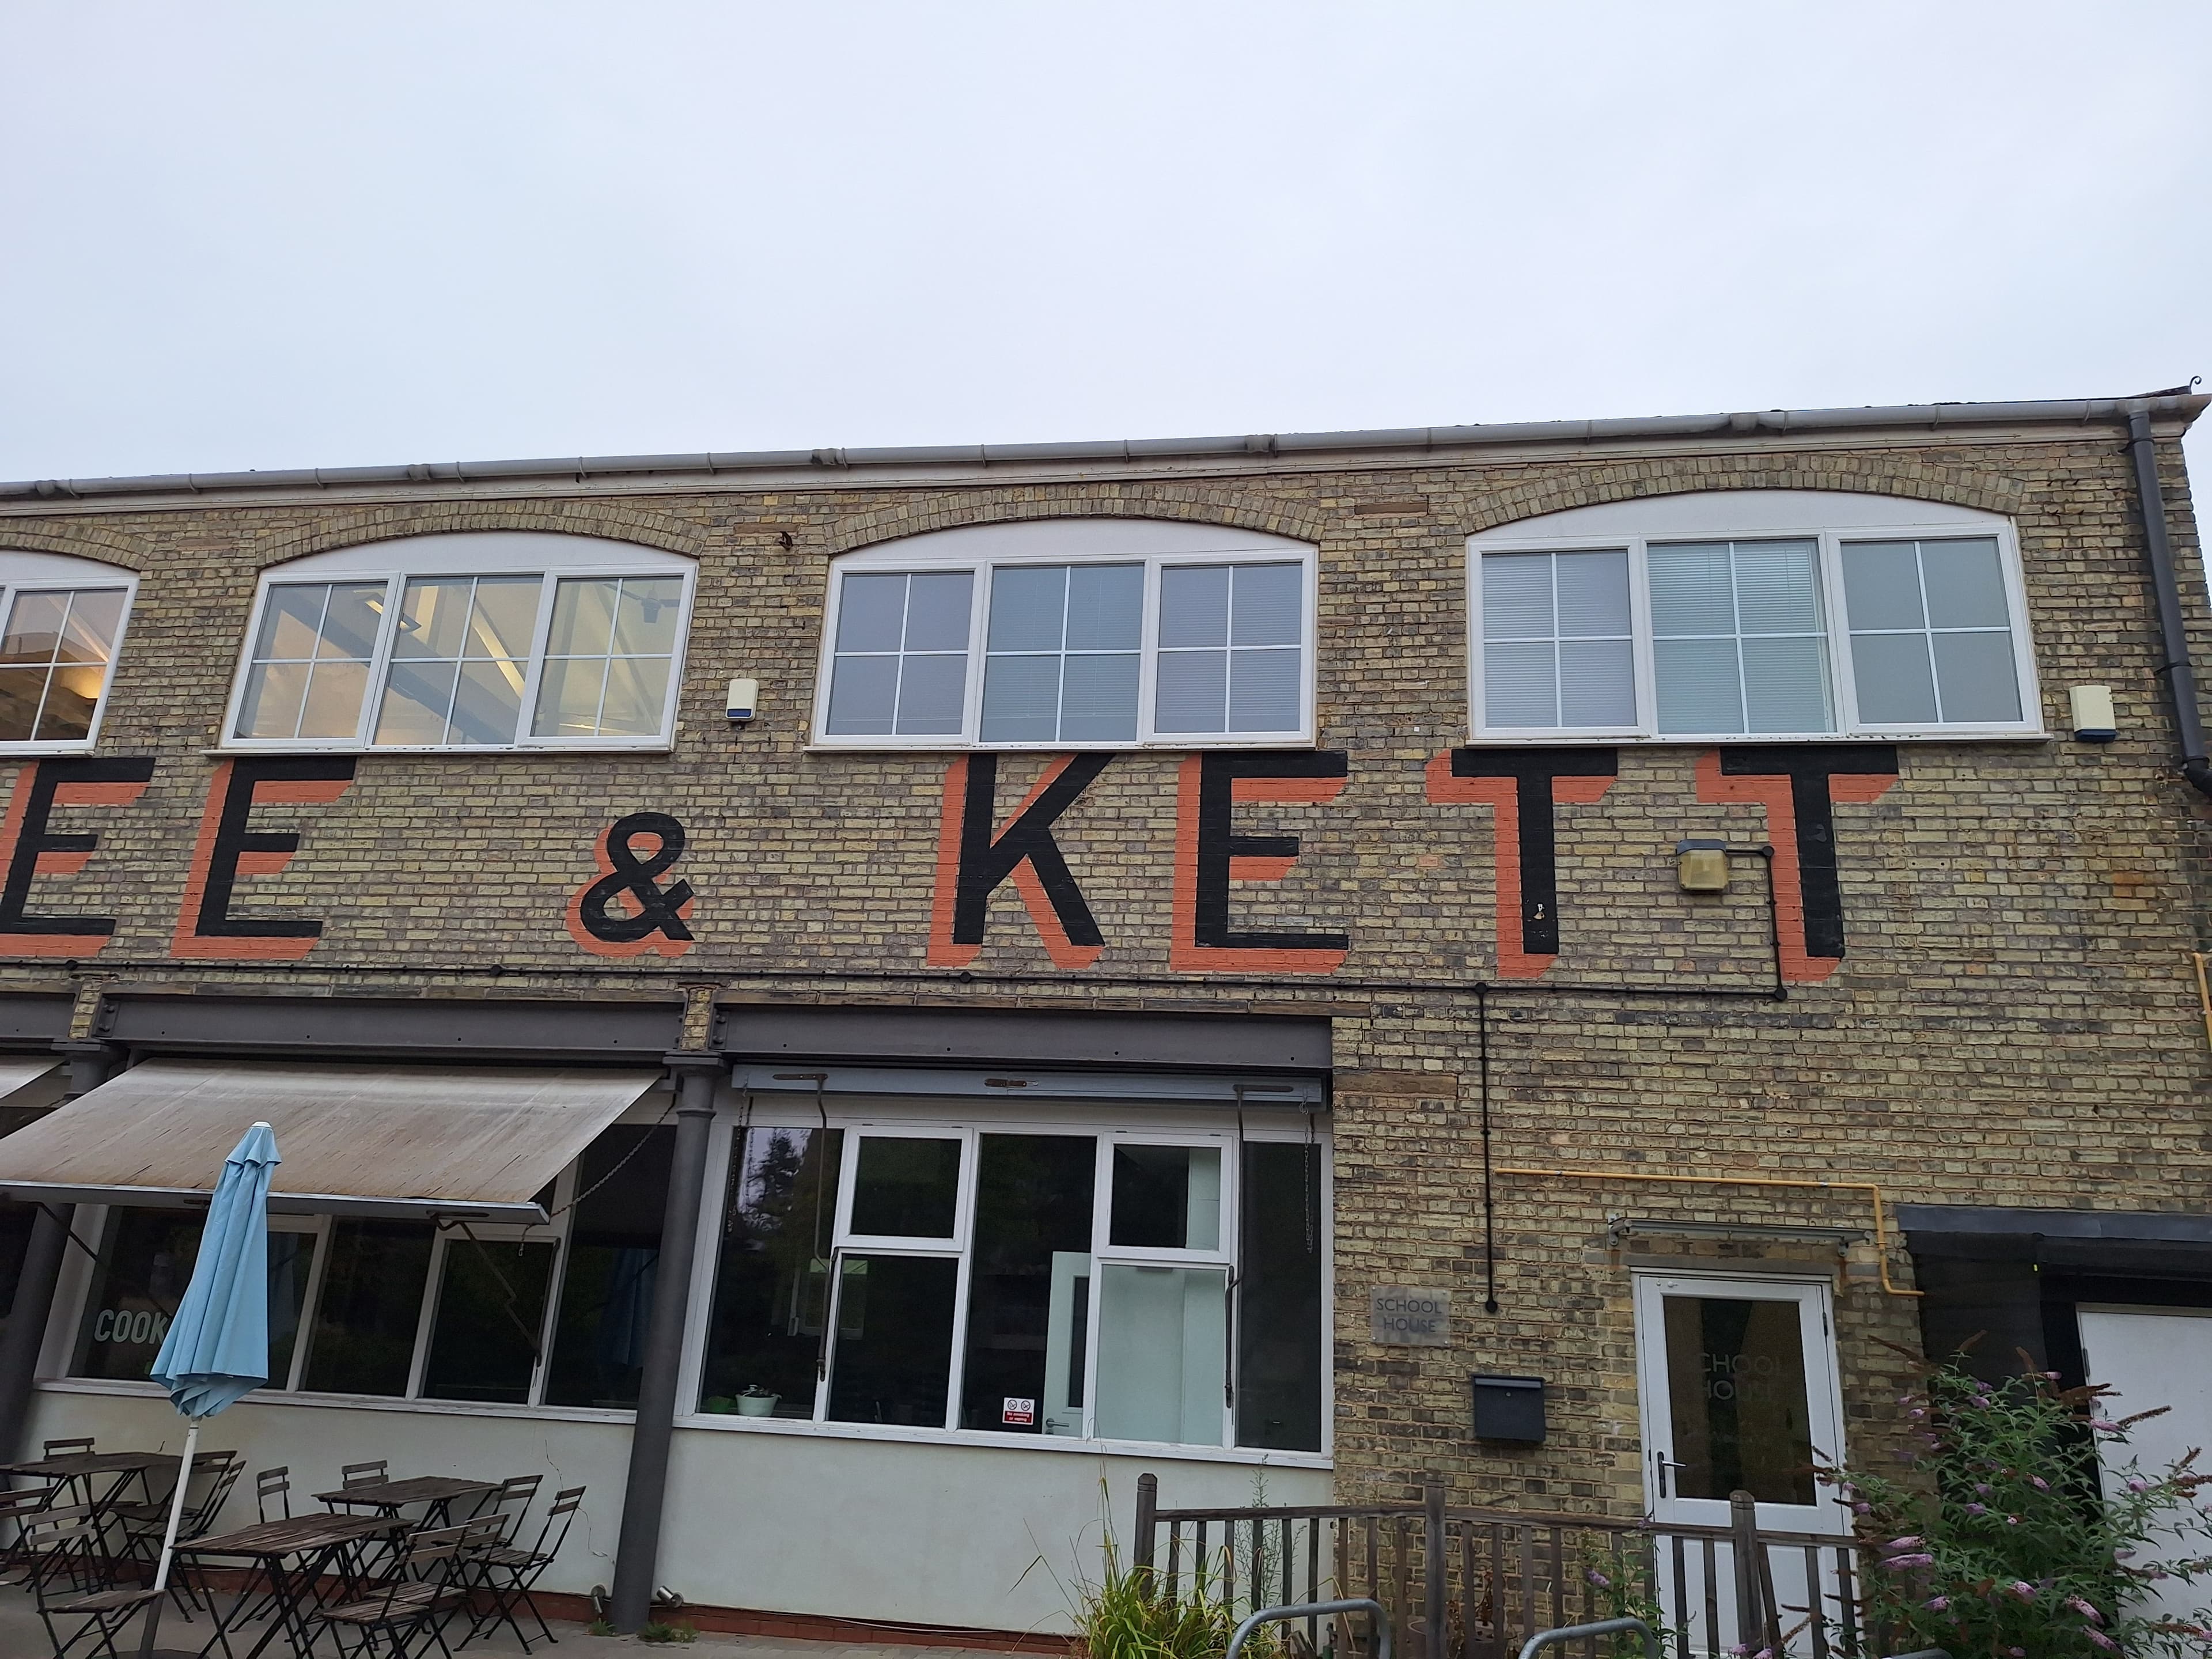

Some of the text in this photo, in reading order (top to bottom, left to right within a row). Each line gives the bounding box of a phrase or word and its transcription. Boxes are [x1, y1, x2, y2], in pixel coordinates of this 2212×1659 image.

[0, 747, 1900, 982] EE & KETT
[1376, 1298, 1442, 1314] SCHOOL
[94, 1309, 168, 1344] COOK
[1384, 1317, 1436, 1332] HOUSE
